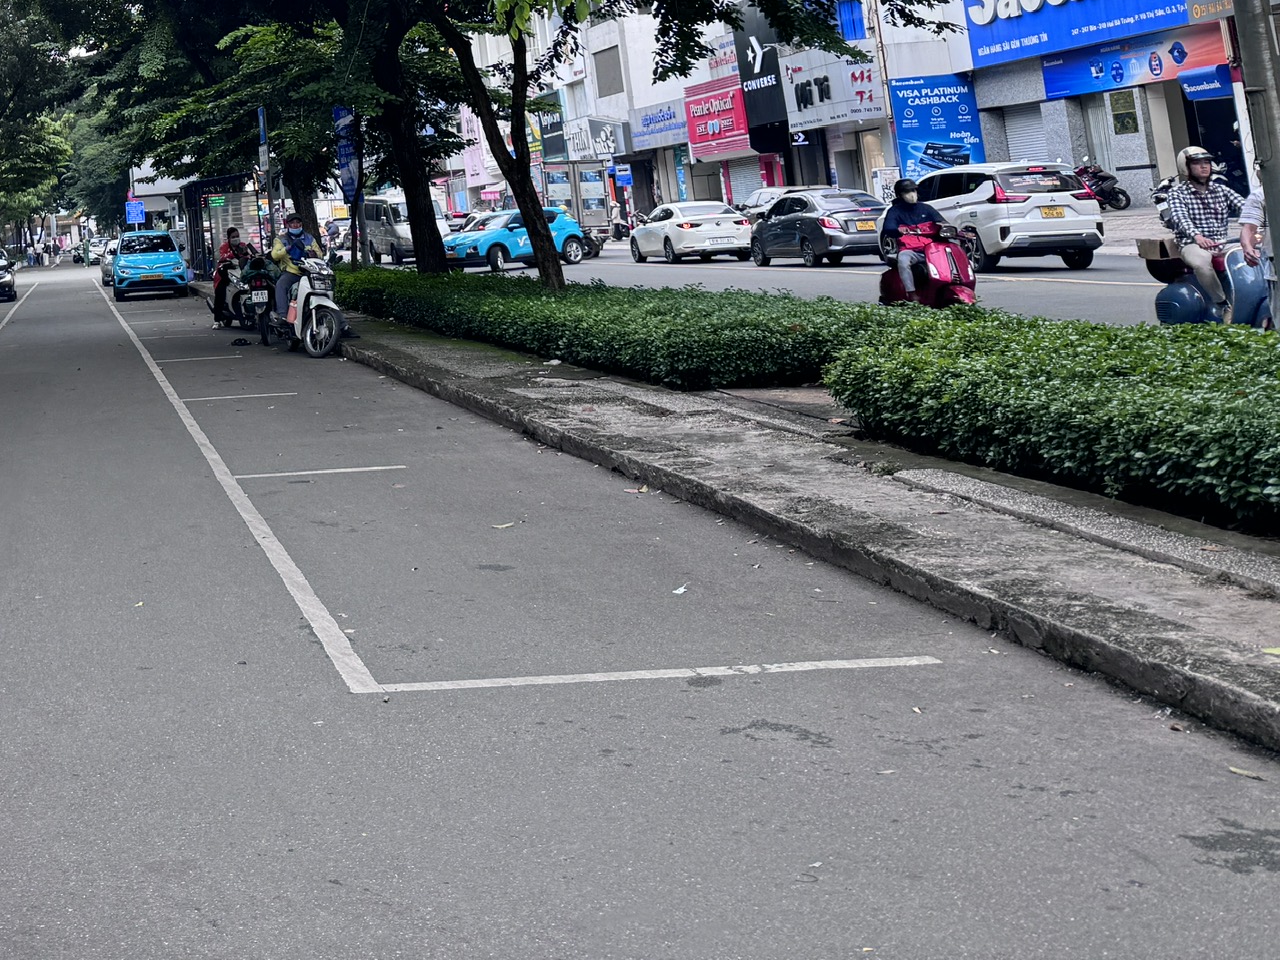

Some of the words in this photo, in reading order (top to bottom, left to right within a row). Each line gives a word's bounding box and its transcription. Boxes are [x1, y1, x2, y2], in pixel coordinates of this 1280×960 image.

[743, 74, 776, 92] CONVERSE
[1183, 79, 1222, 93] Sacombank
[897, 88, 920, 98] VISA
[921, 85, 968, 97] PLATINUM
[689, 100, 709, 117] Pearle
[709, 96, 733, 115] Optical
[908, 94, 959, 106] CASHBACK
[950, 130, 971, 139] Hoàn
